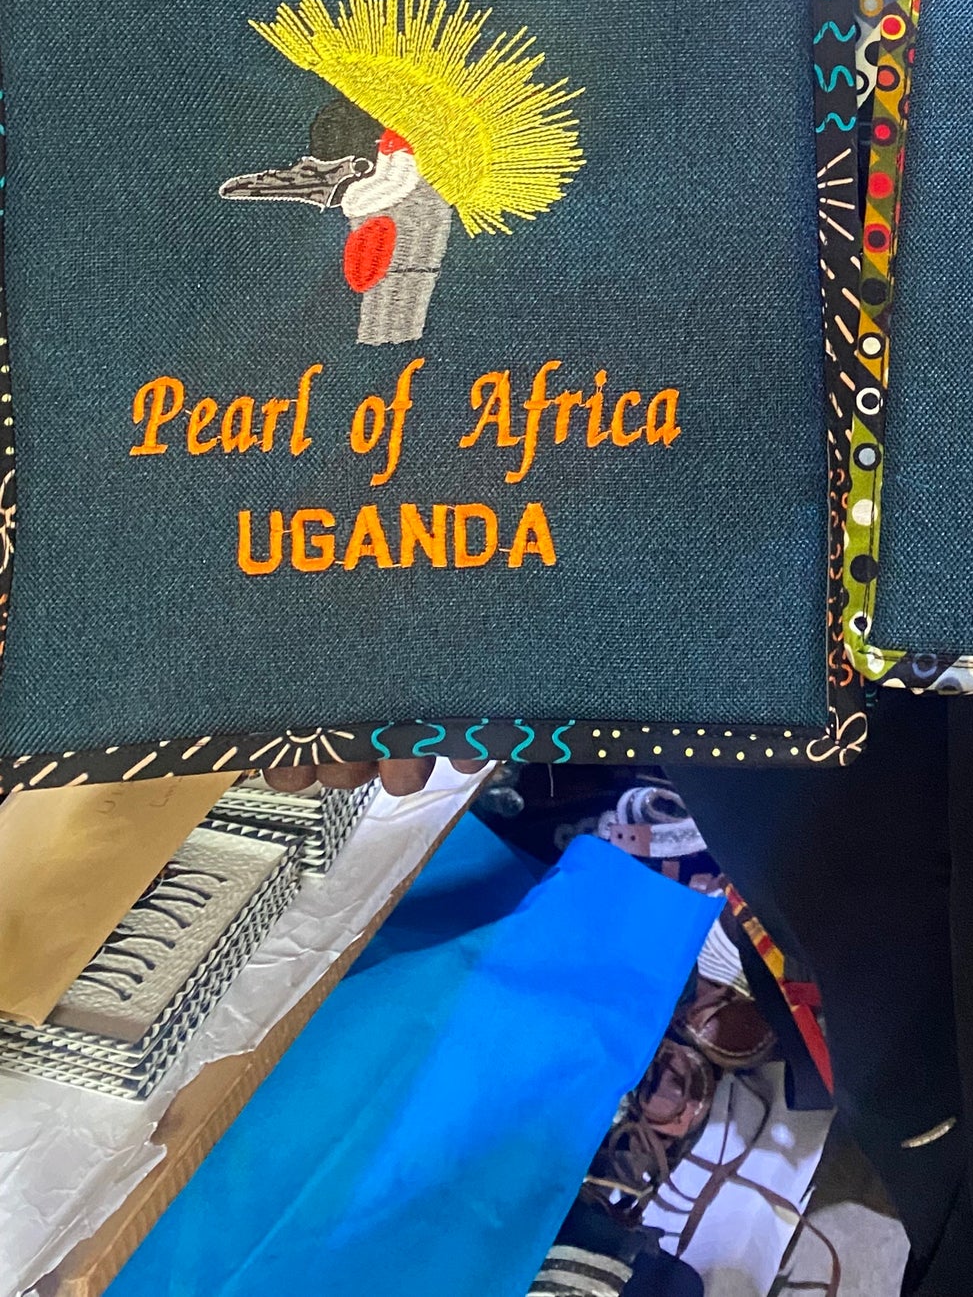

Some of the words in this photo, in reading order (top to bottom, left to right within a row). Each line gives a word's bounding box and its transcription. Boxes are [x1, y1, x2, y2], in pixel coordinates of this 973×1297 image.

[130, 363, 323, 457] Pearl
[349, 357, 425, 486] of
[459, 360, 681, 484] Africa
[237, 502, 557, 575] UGANDA
